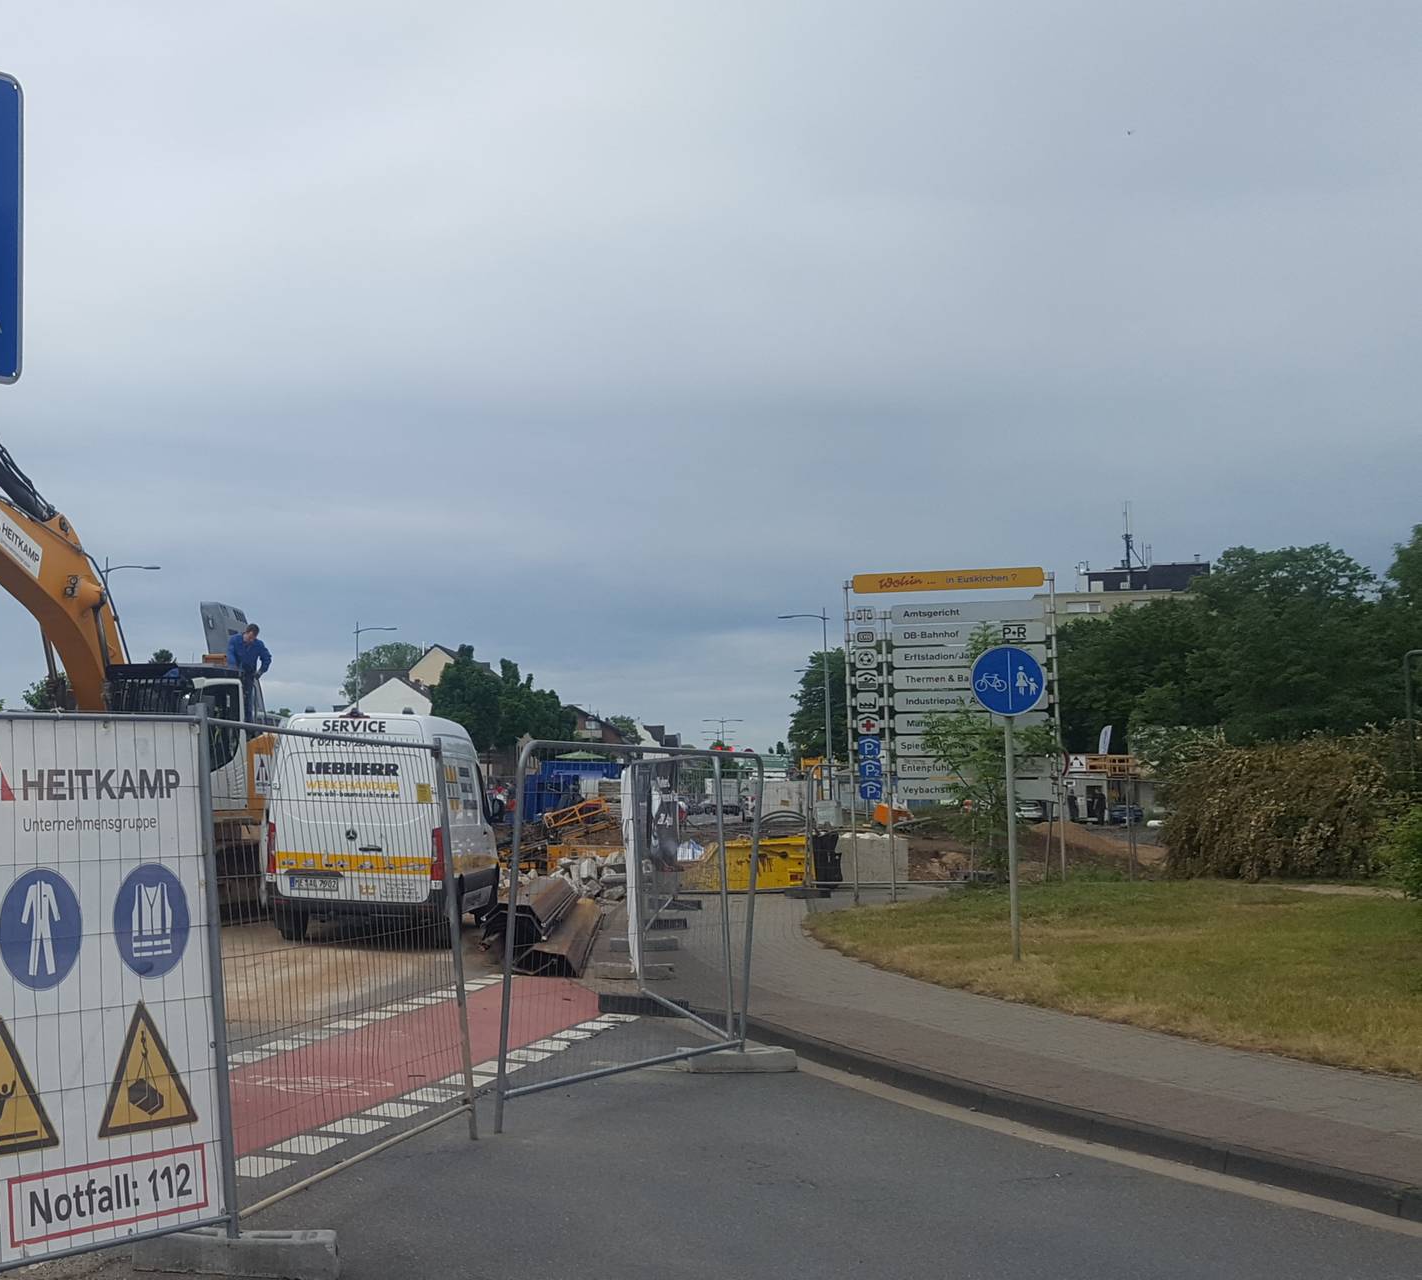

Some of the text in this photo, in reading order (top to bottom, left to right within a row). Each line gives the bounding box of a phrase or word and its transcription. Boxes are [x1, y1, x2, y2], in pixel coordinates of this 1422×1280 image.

[2, 522, 40, 562] HEITKAMP
[946, 575, 955, 584] in
[958, 574, 1008, 584] Euskirchen
[903, 608, 960, 619] Amtsgericht
[903, 630, 959, 640] DB-Bahnhof
[906, 674, 969, 683] Thermen & Ba
[322, 719, 386, 733] SERVICE
[306, 762, 399, 776] LIEBHERR
[901, 763, 949, 773] Entenpfuhl
[22, 769, 180, 802] HEITKAMP
[23, 815, 157, 833] Unternehmensgruppe
[29, 1163, 194, 1227] Notfall: 112
